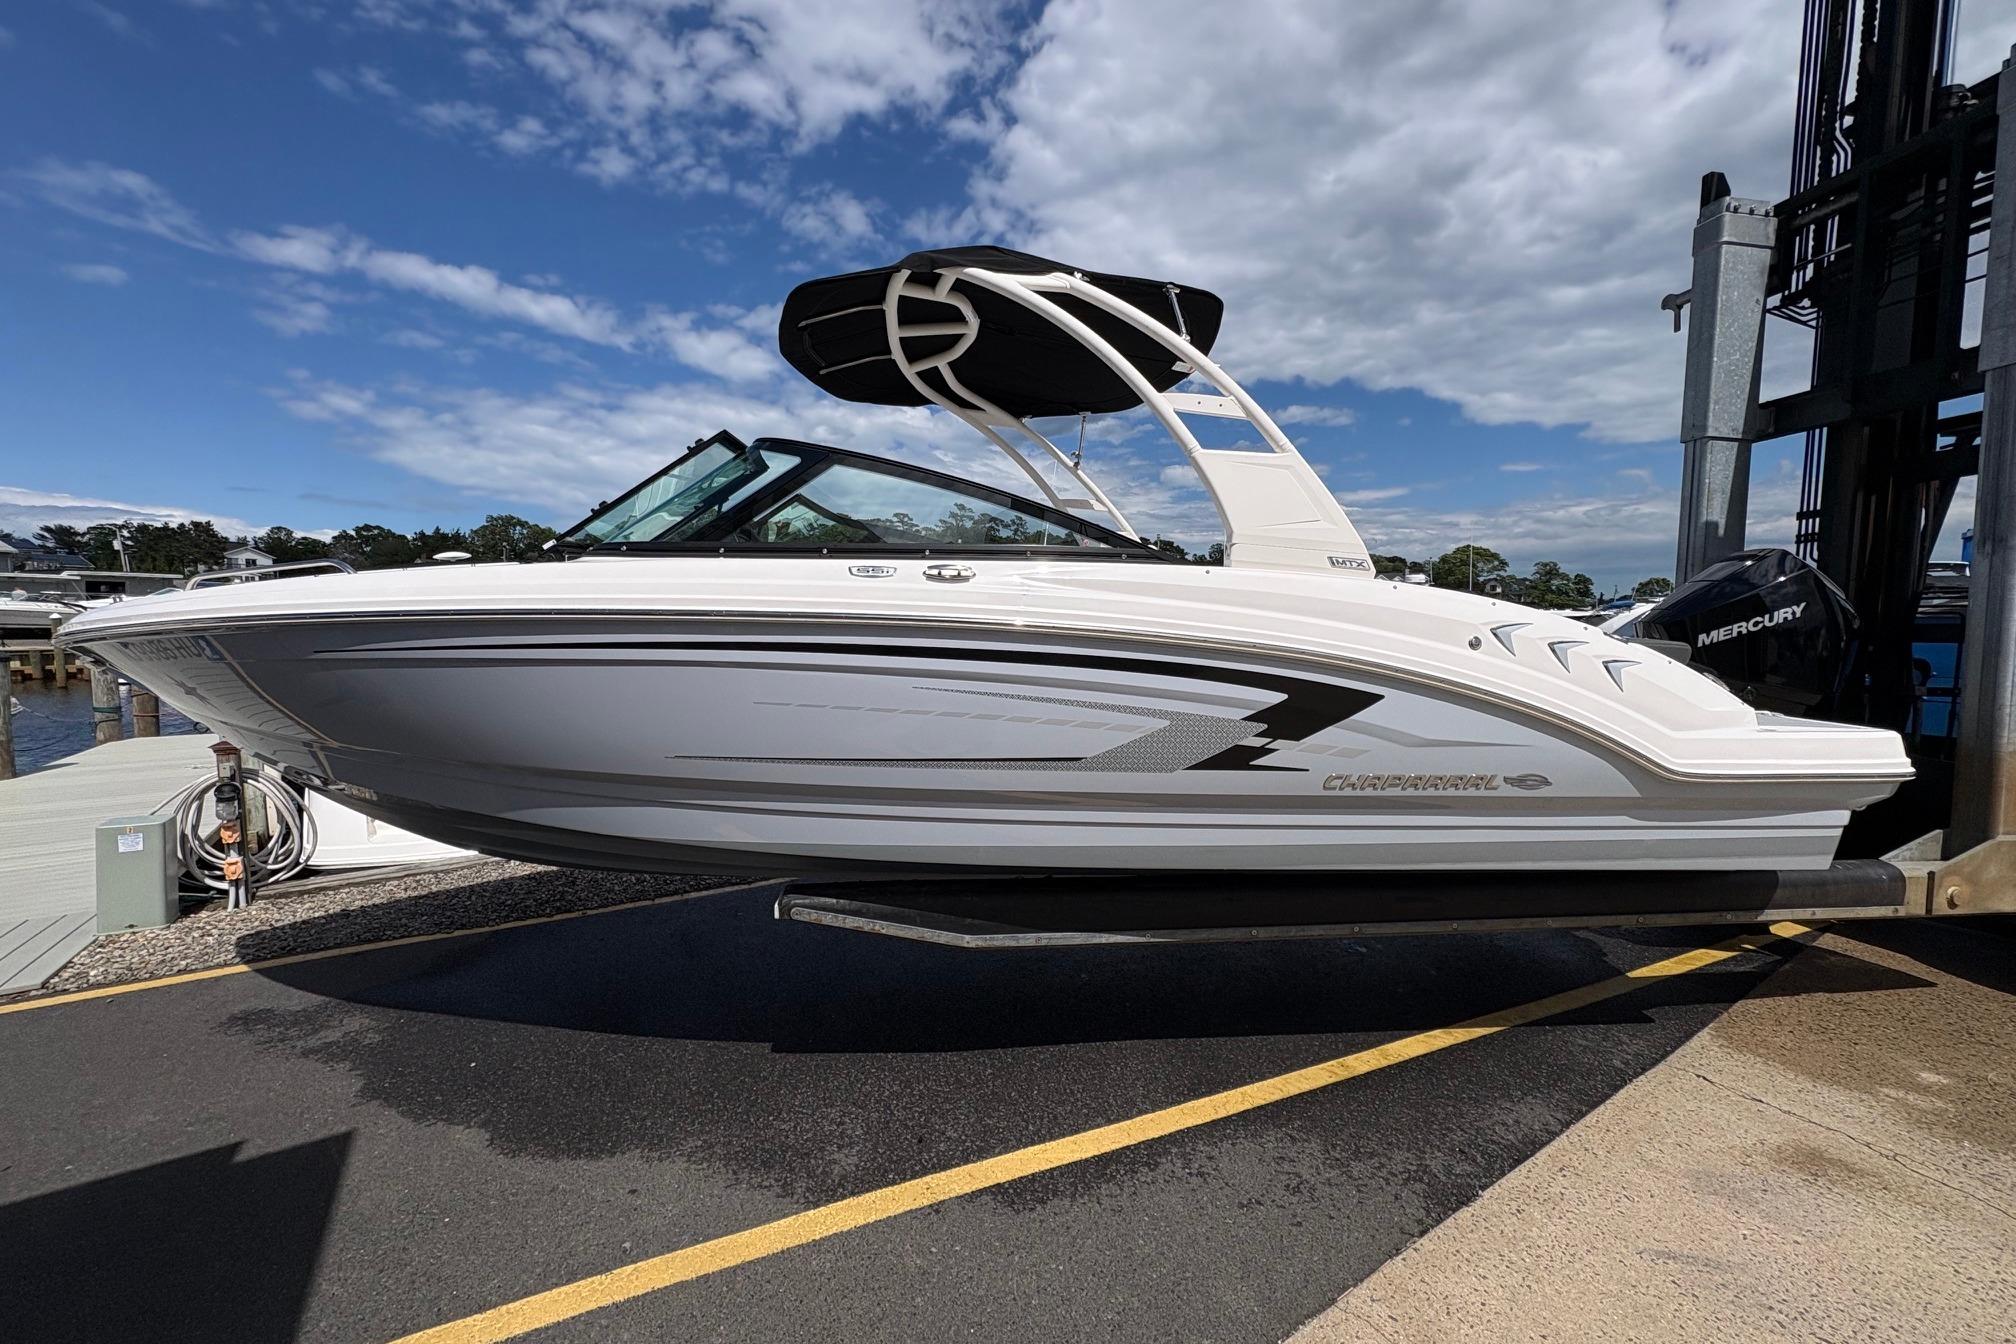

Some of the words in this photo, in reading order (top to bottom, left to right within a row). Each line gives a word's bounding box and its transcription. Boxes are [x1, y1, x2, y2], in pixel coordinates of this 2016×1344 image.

[1697, 601, 1807, 648] MERCURY
[167, 635, 202, 658] HU
[1322, 773, 1501, 791] CHAPARRAL
